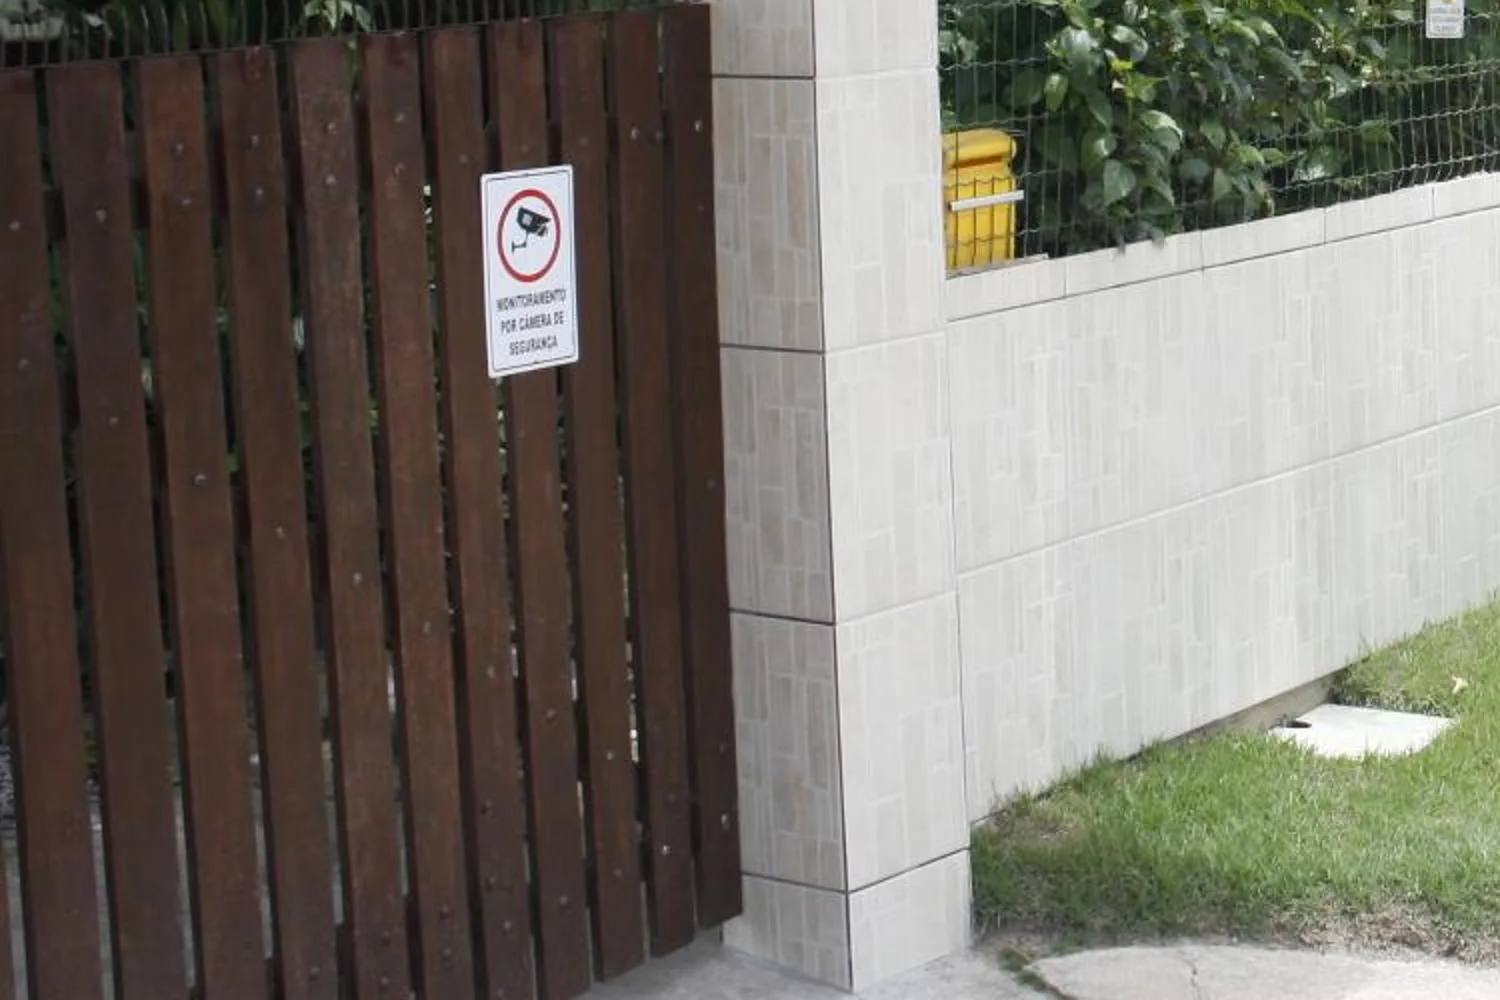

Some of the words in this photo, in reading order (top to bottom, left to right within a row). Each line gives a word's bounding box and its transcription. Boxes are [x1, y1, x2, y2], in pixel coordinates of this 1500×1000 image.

[497, 288, 566, 311] MONITORAMENTO
[500, 319, 516, 333] POR
[553, 311, 564, 325] DE
